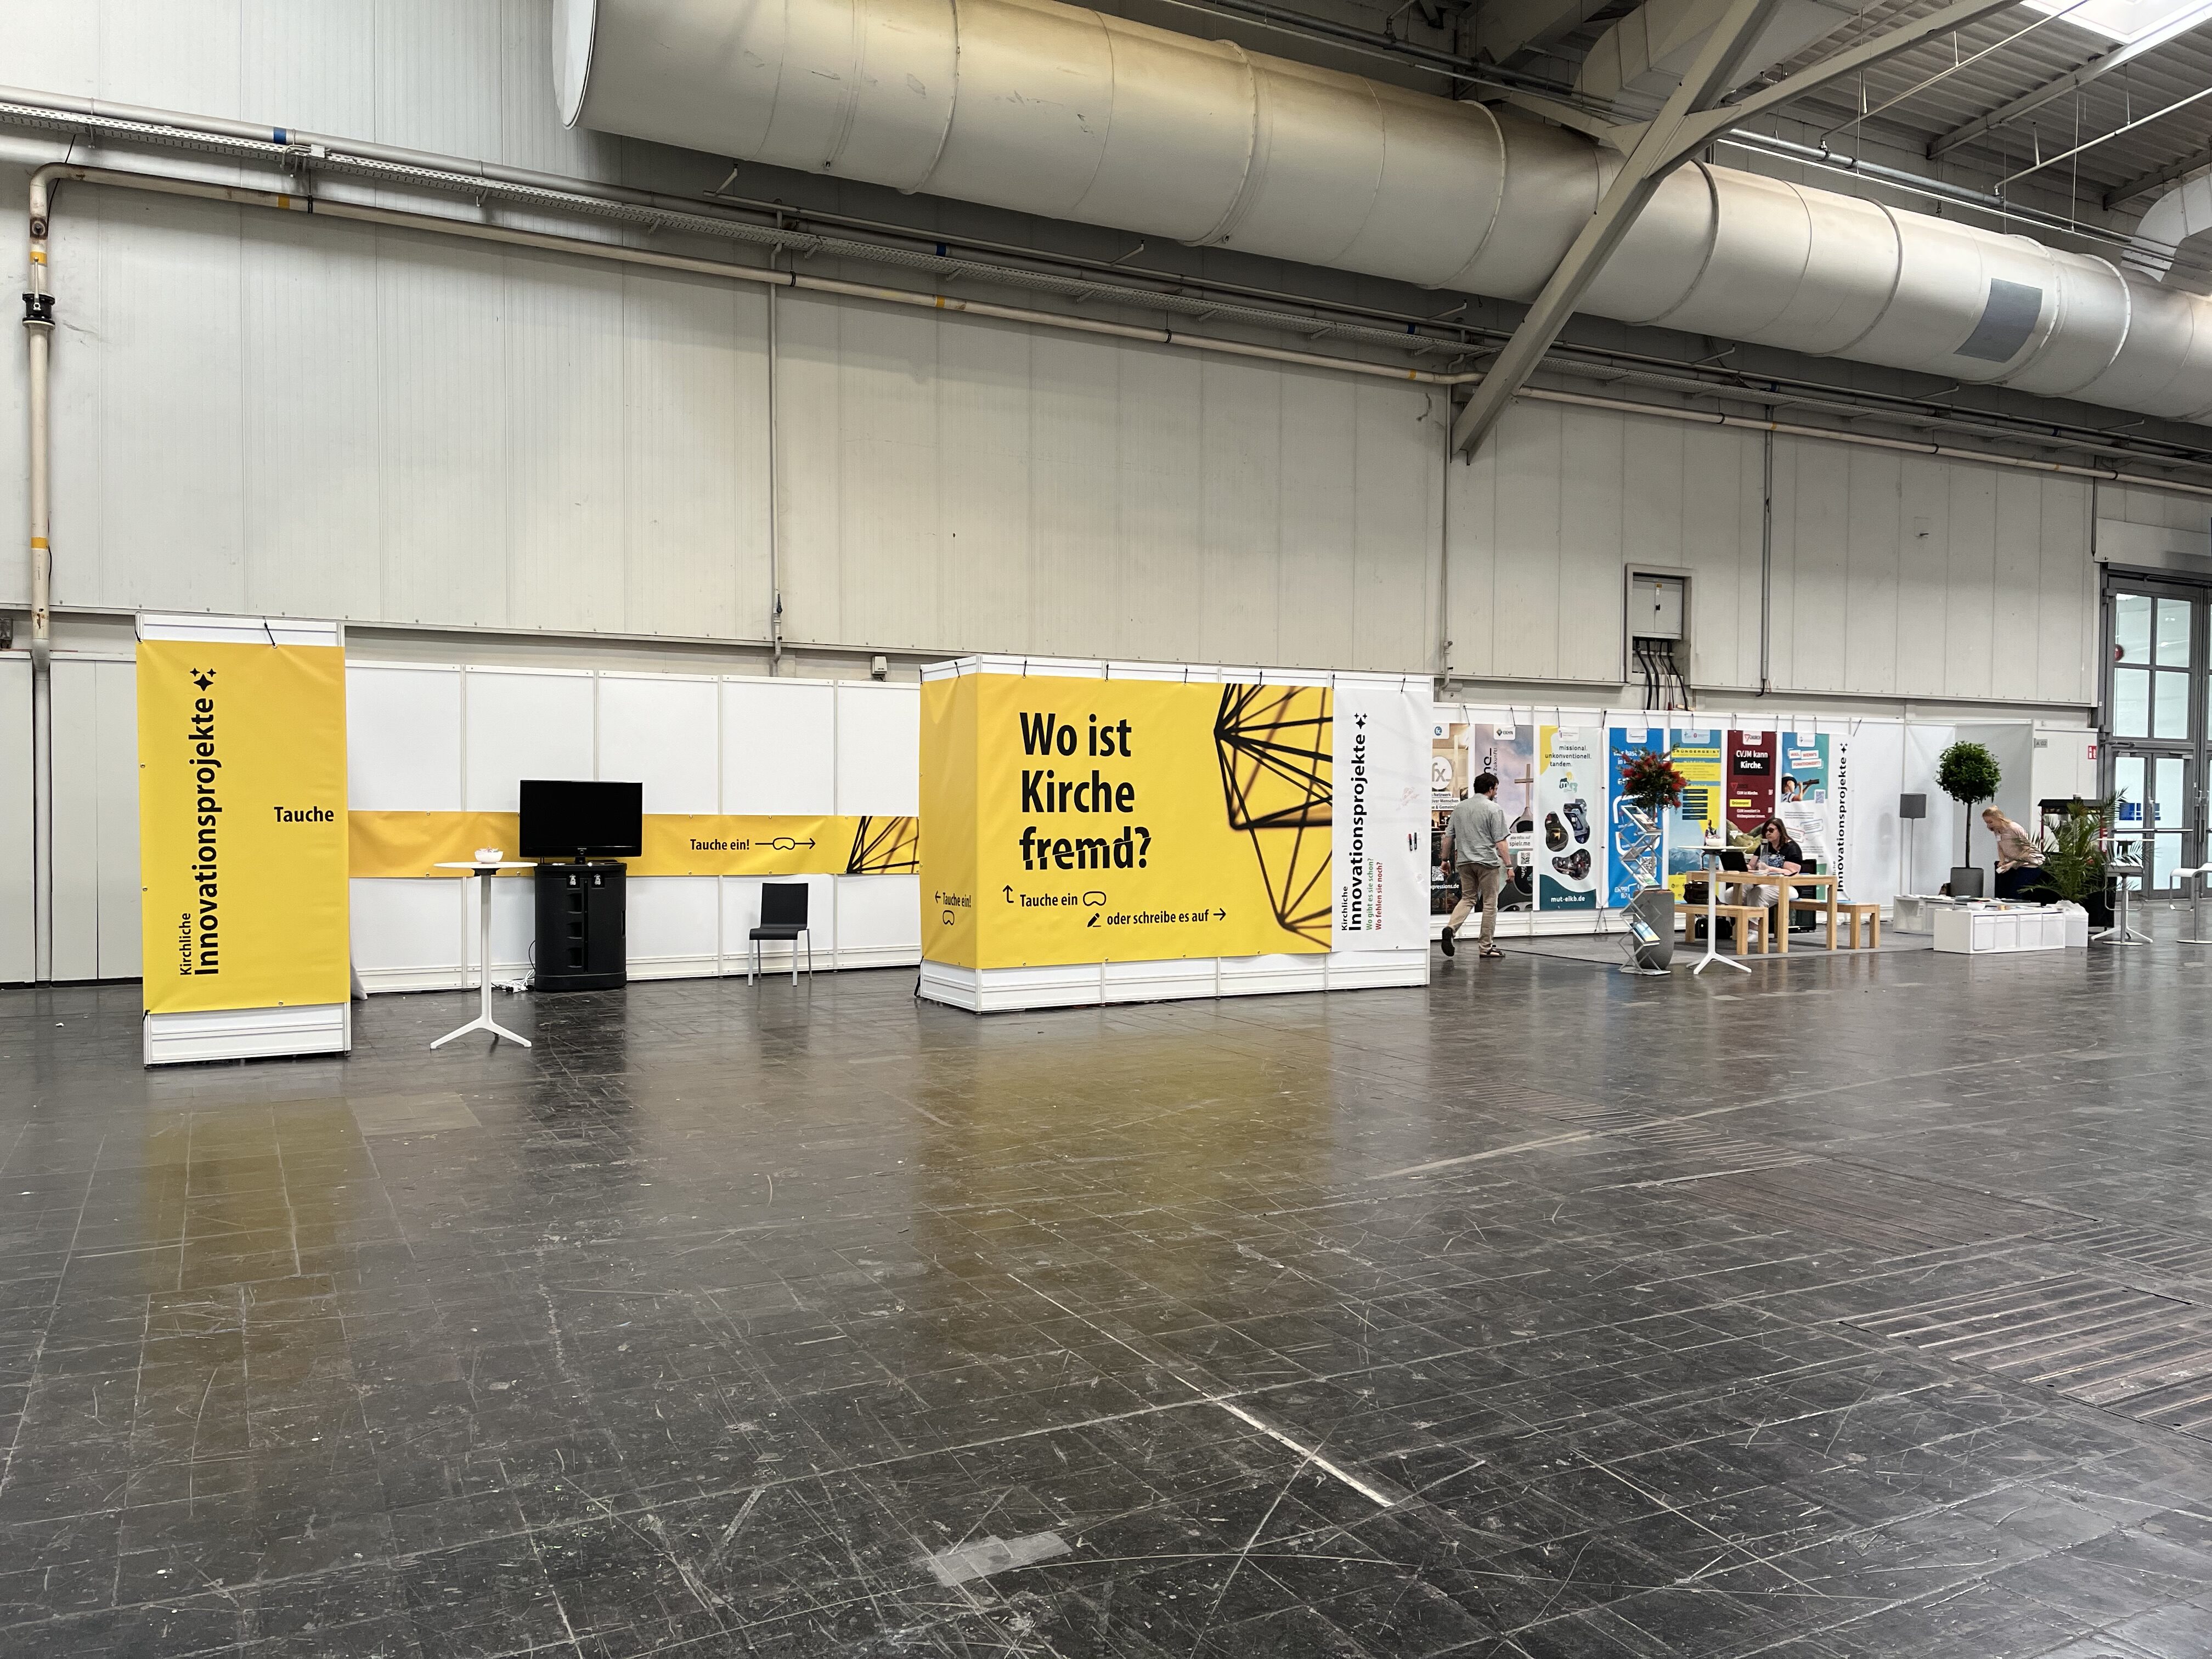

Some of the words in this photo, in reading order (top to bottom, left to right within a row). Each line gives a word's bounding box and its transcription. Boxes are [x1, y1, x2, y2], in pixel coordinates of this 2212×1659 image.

[1019, 712, 1077, 757] Wo
[1088, 713, 1132, 757] ist
[1736, 749, 1752, 758] CVJM
[1753, 750, 1768, 758] kann
[1740, 761, 1763, 769] Kirche.
[1022, 769, 1135, 813] Kirche
[274, 806, 334, 822] Tauche
[1348, 734, 1368, 931] Innovationsprojekte
[1837, 757, 1848, 893] Innovationsprojekte
[188, 698, 223, 975] Innovationsprojekte
[690, 838, 727, 850] Tauche
[730, 838, 749, 851] ein!
[1019, 826, 1152, 871] fremd?
[943, 892, 961, 907] Tauche
[961, 894, 972, 908] ein!
[1019, 893, 1058, 907] Tauche
[1061, 893, 1078, 906] ein
[1107, 912, 1131, 926] oder
[1133, 910, 1176, 924] schreibe
[1178, 913, 1189, 922] es
[1192, 909, 1209, 922] auf
[1366, 919, 1373, 930] Wo
[1375, 919, 1382, 930] Wo
[178, 913, 191, 975] Kirchliche
